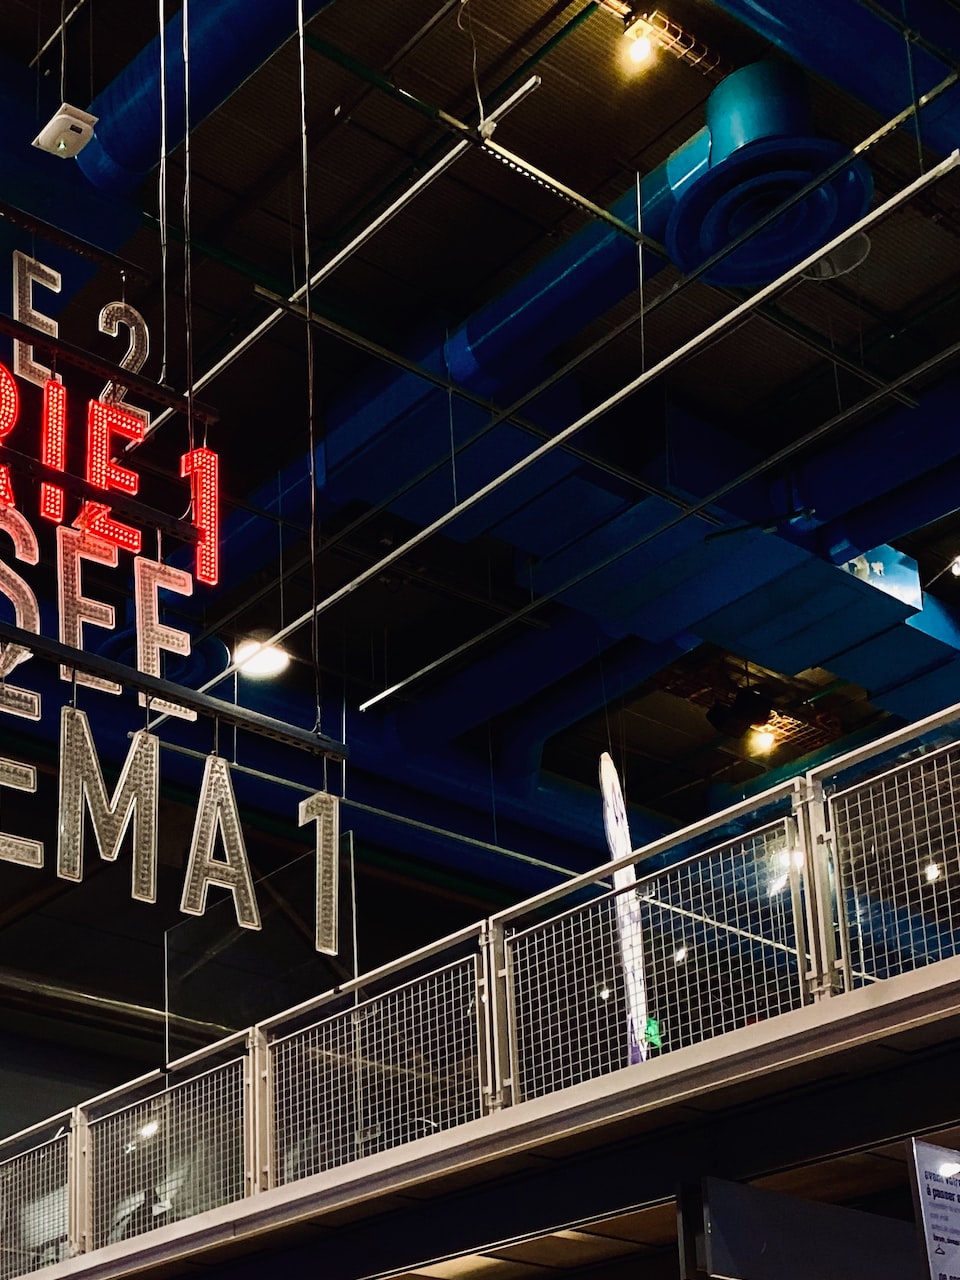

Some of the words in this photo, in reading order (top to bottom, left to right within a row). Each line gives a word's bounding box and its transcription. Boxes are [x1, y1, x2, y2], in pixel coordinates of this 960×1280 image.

[98, 301, 151, 429] 2
[181, 446, 220, 586] 1
[298, 791, 340, 956] 1
